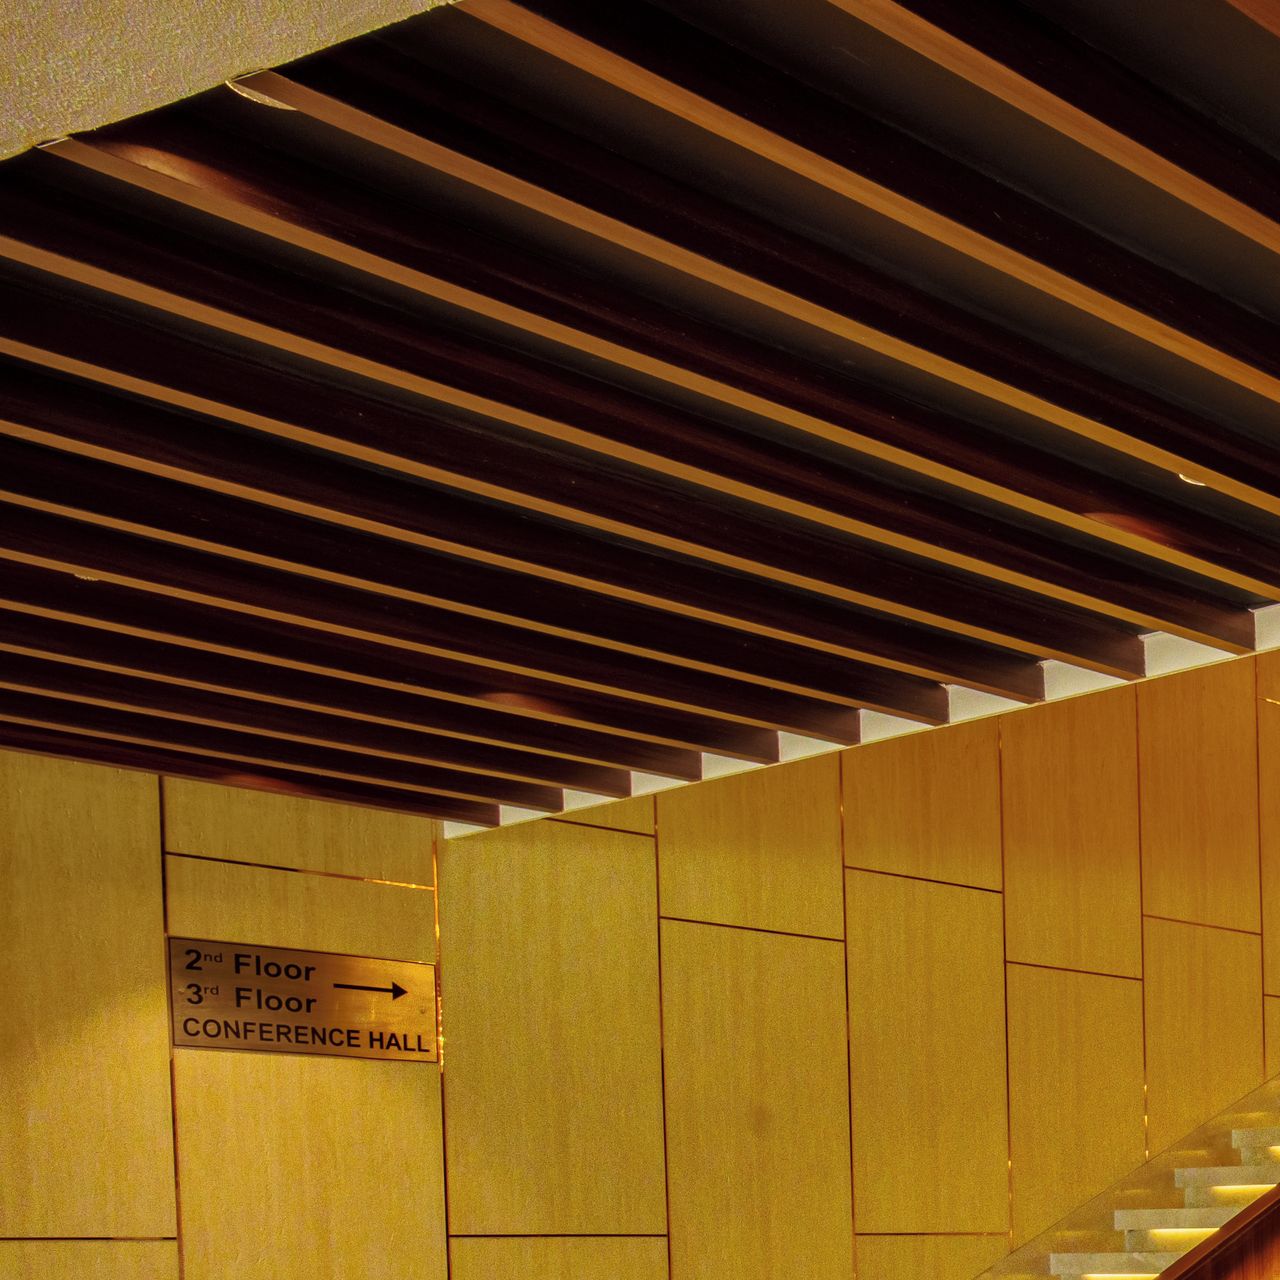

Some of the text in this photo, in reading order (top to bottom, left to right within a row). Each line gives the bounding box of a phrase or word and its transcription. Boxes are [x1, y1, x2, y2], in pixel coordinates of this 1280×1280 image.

[184, 949, 317, 981] 2nd Floor
[186, 983, 318, 1013] 3rd Floor
[182, 1017, 430, 1053] CONFERENCE HALL
